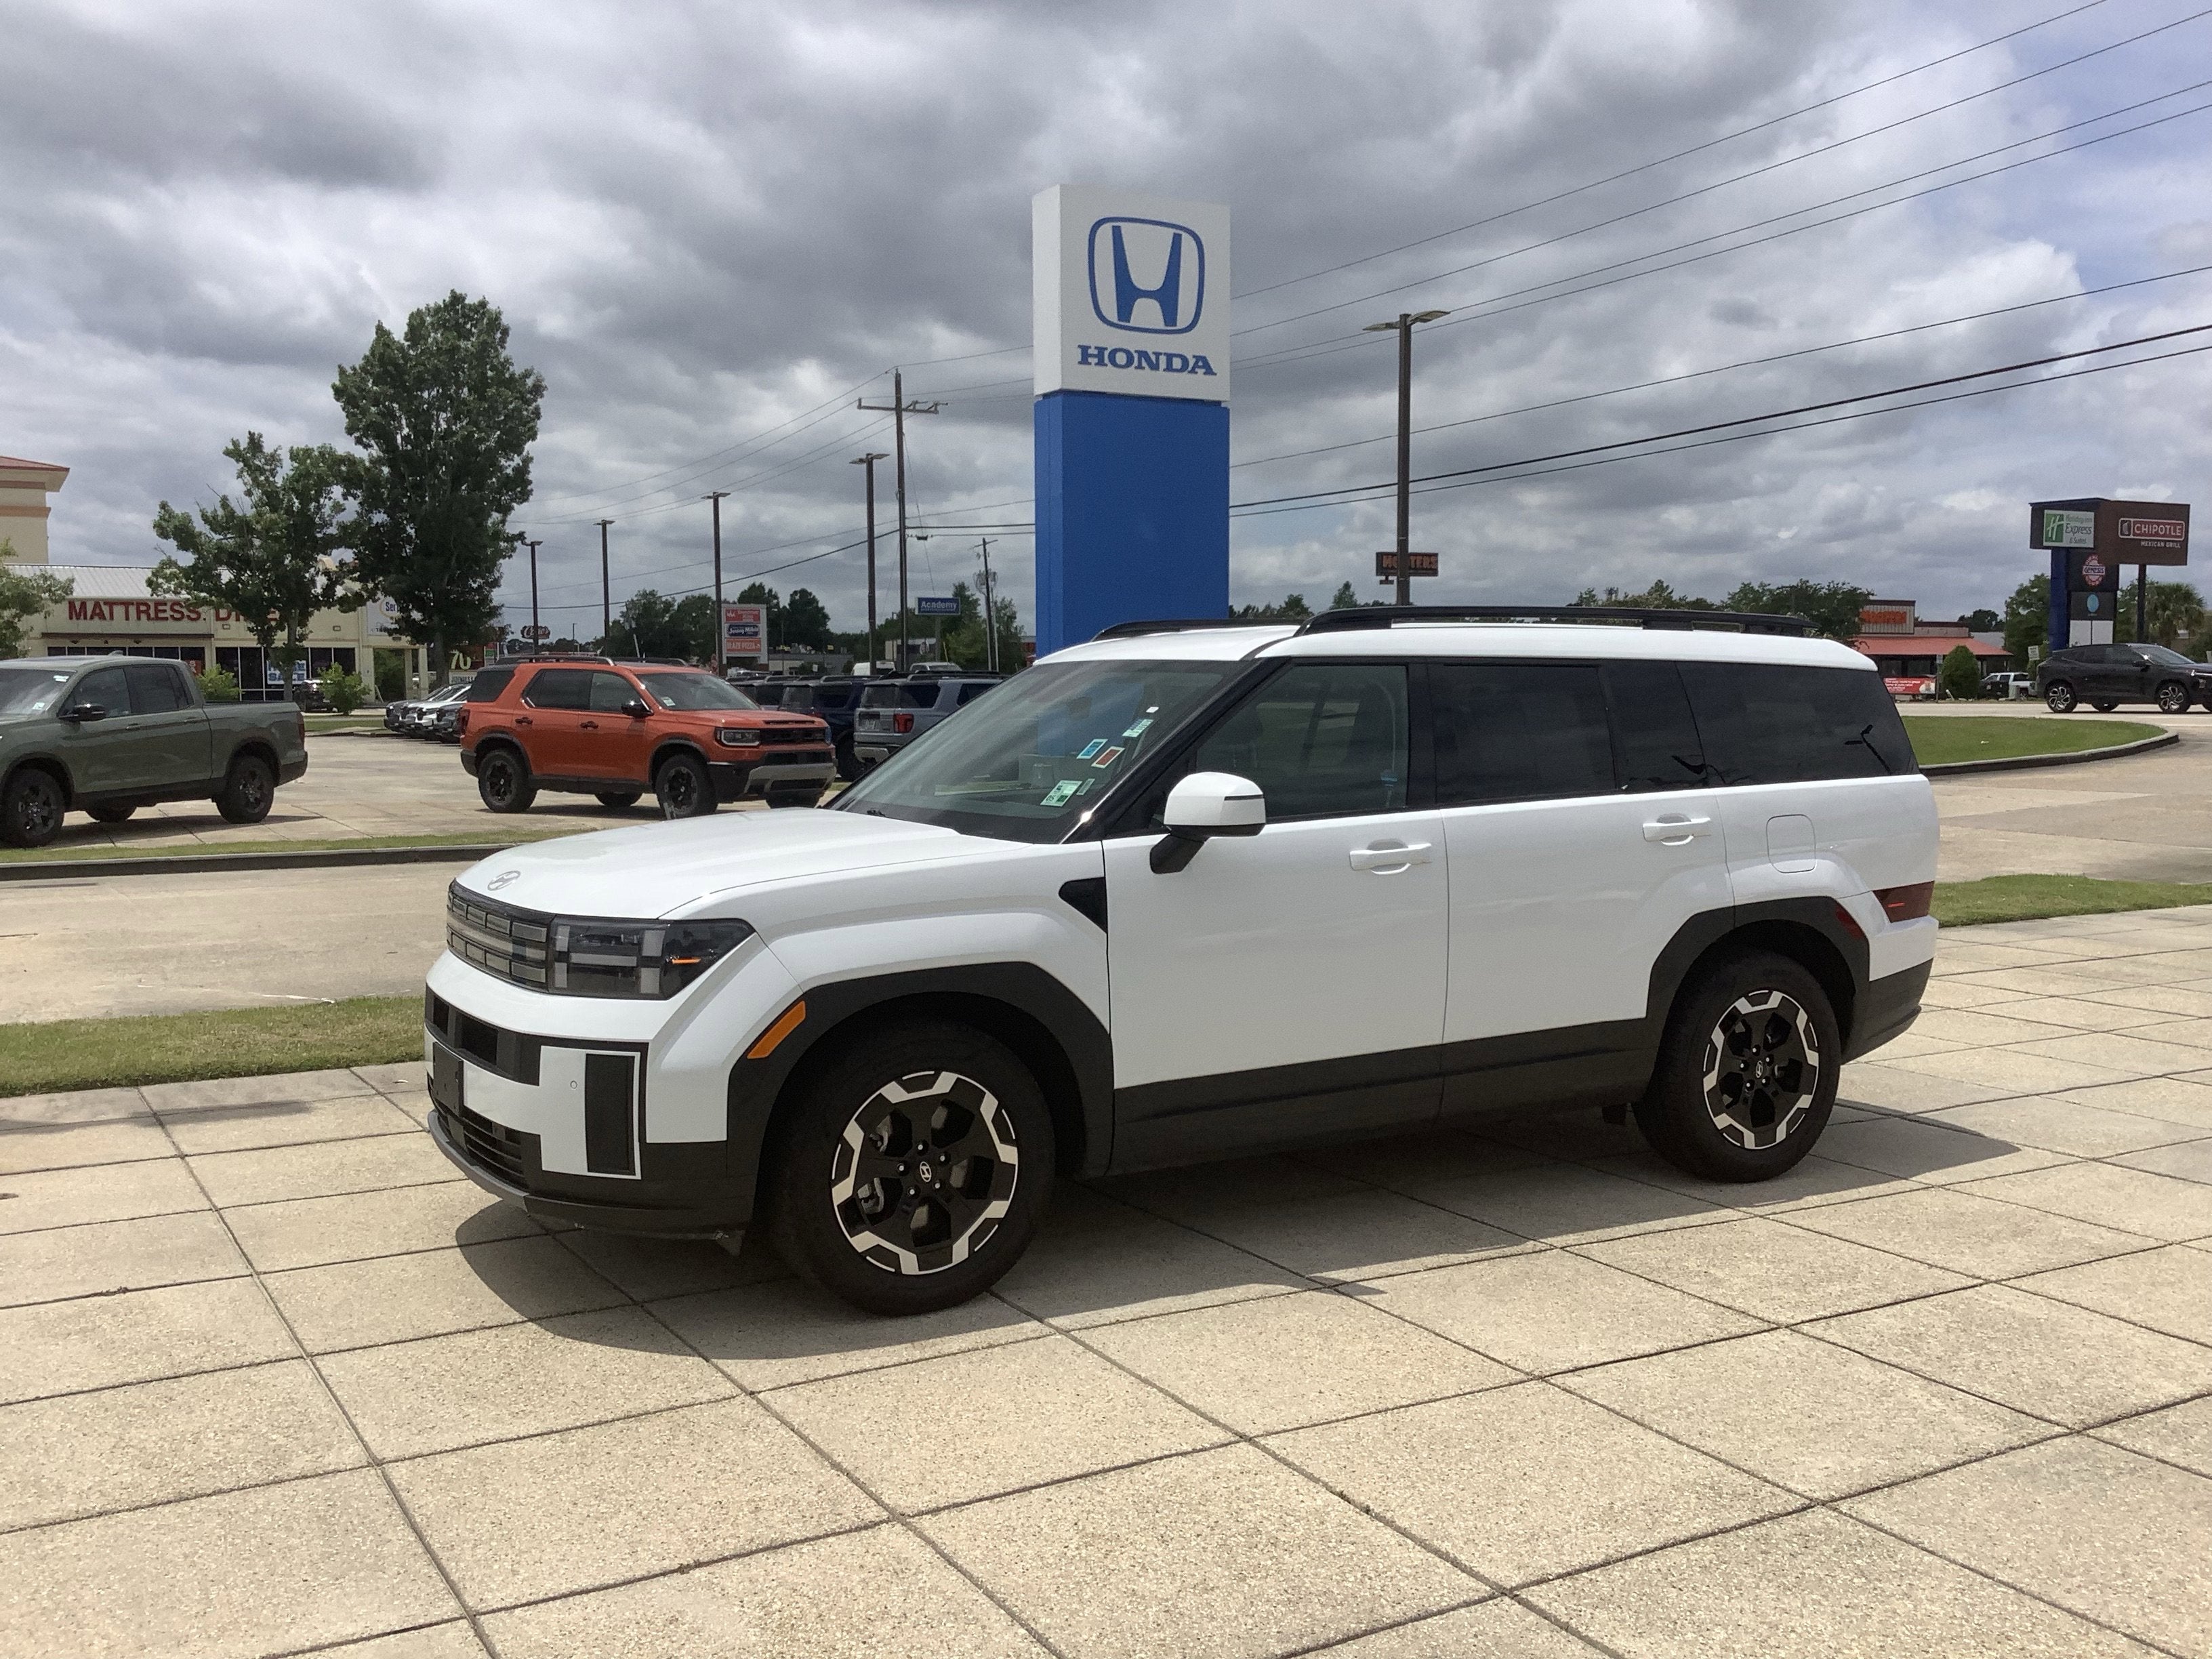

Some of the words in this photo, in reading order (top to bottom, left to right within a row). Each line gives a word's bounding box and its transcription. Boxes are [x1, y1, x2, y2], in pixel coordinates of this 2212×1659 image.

[1078, 344, 1217, 376] HONDA
[2065, 523, 2092, 536] Express
[2134, 523, 2182, 536] CHIPOTLE
[1382, 555, 1437, 569] HOTERS
[68, 600, 203, 621] MATTRESS
[921, 600, 957, 611] Academy
[741, 641, 756, 649] PIZZA
